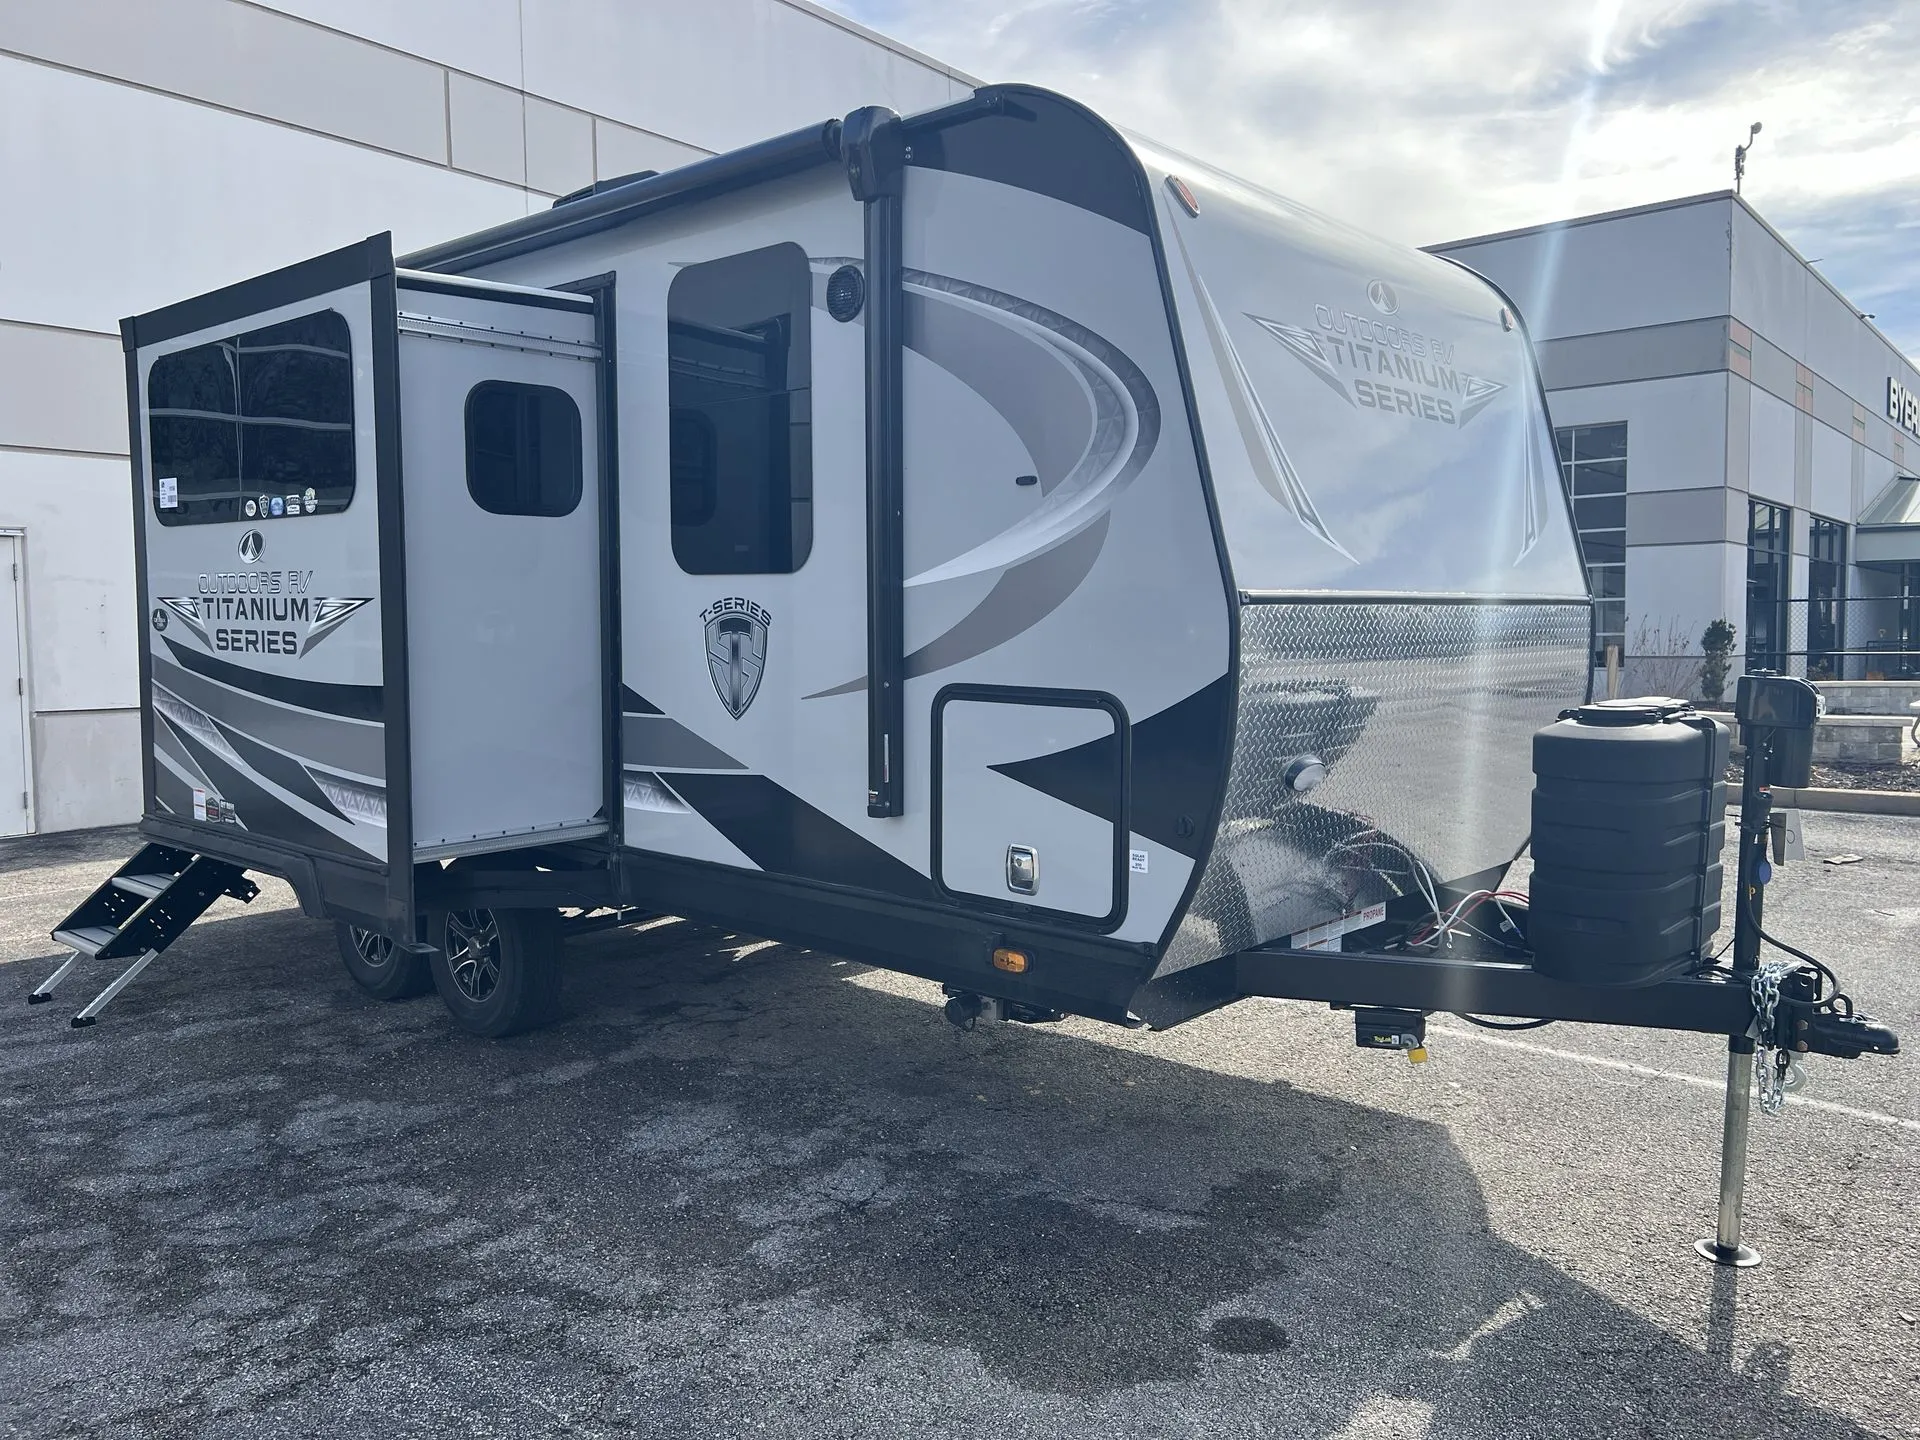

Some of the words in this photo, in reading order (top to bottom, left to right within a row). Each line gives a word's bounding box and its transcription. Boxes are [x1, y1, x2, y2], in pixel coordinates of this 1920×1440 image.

[1315, 303, 1426, 358] OUTDOORS
[1430, 338, 1455, 366] RV
[1326, 335, 1460, 394] TITANIUM
[1354, 378, 1456, 425] SERIES
[1887, 376, 1920, 439] BYER
[198, 571, 281, 595] OUTDOORS
[288, 570, 313, 594] RV
[202, 597, 309, 622] TITANIUM
[699, 597, 772, 627] T-SERIES
[216, 628, 298, 655] SERIES
[1363, 906, 1385, 921] PROPANE
